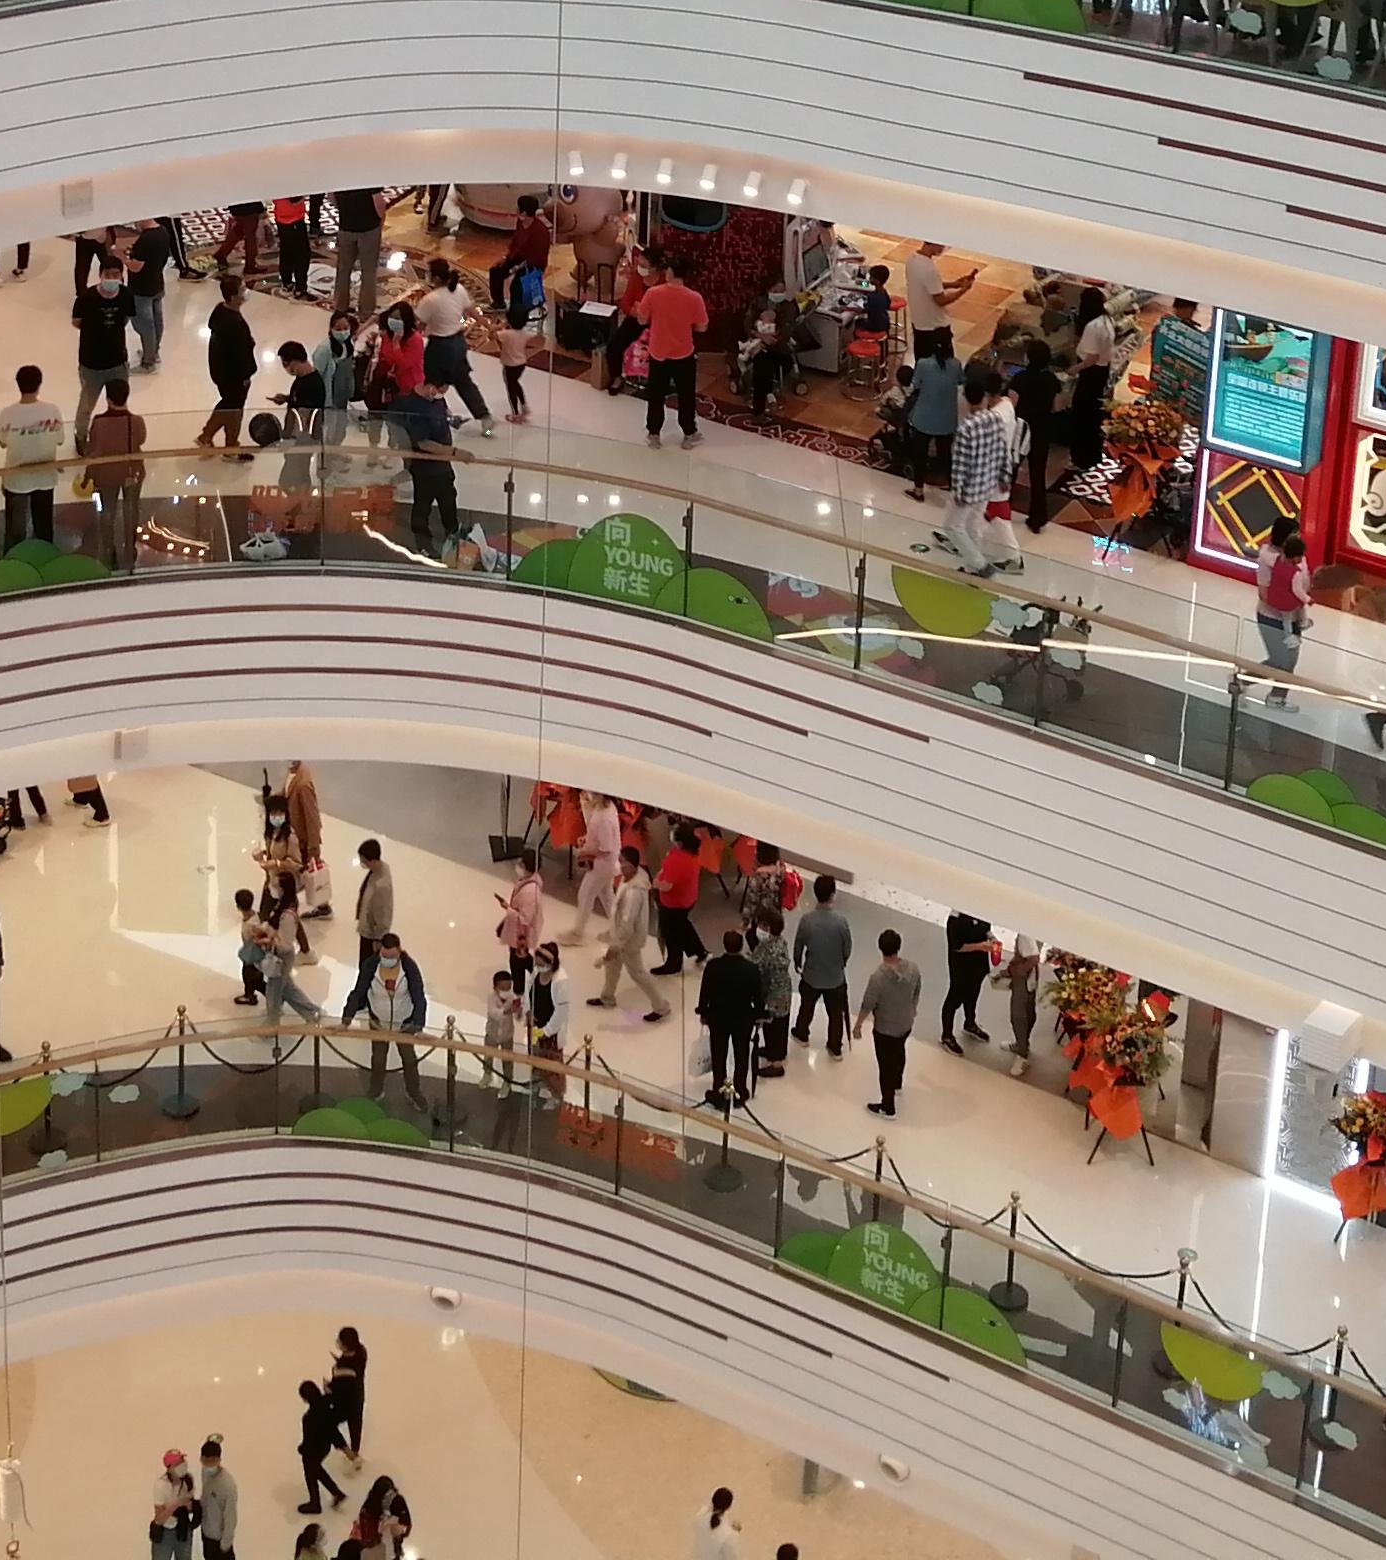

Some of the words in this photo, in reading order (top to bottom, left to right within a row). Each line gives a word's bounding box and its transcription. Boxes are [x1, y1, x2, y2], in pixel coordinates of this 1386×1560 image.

[604, 516, 631, 548] 向
[603, 544, 673, 577] YOUNG
[603, 566, 650, 597] 新生
[863, 1223, 889, 1255] 向
[862, 1247, 928, 1291] YOUNG
[860, 1266, 905, 1305] 新生
